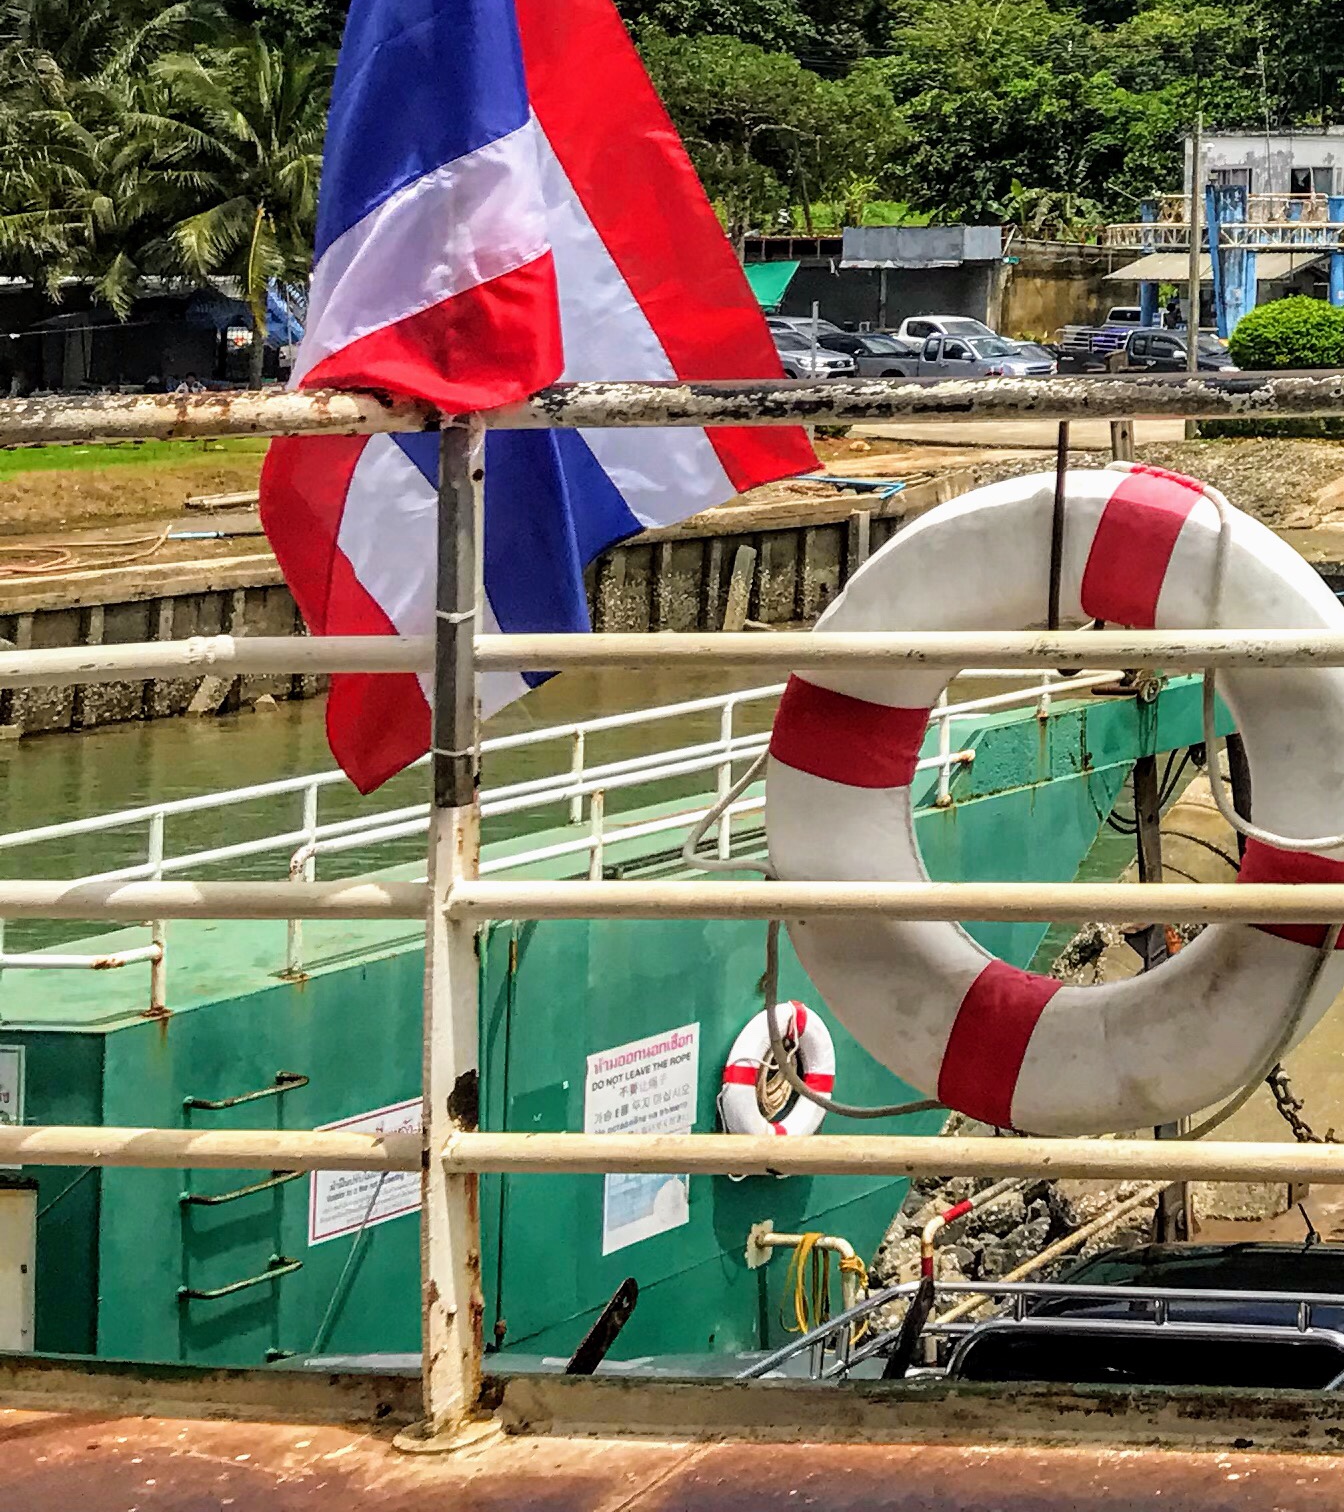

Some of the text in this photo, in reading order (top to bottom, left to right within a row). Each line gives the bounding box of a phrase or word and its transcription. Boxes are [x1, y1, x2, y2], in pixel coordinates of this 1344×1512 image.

[592, 1051, 692, 1091] DO NOT LEAVE THE ROPE
